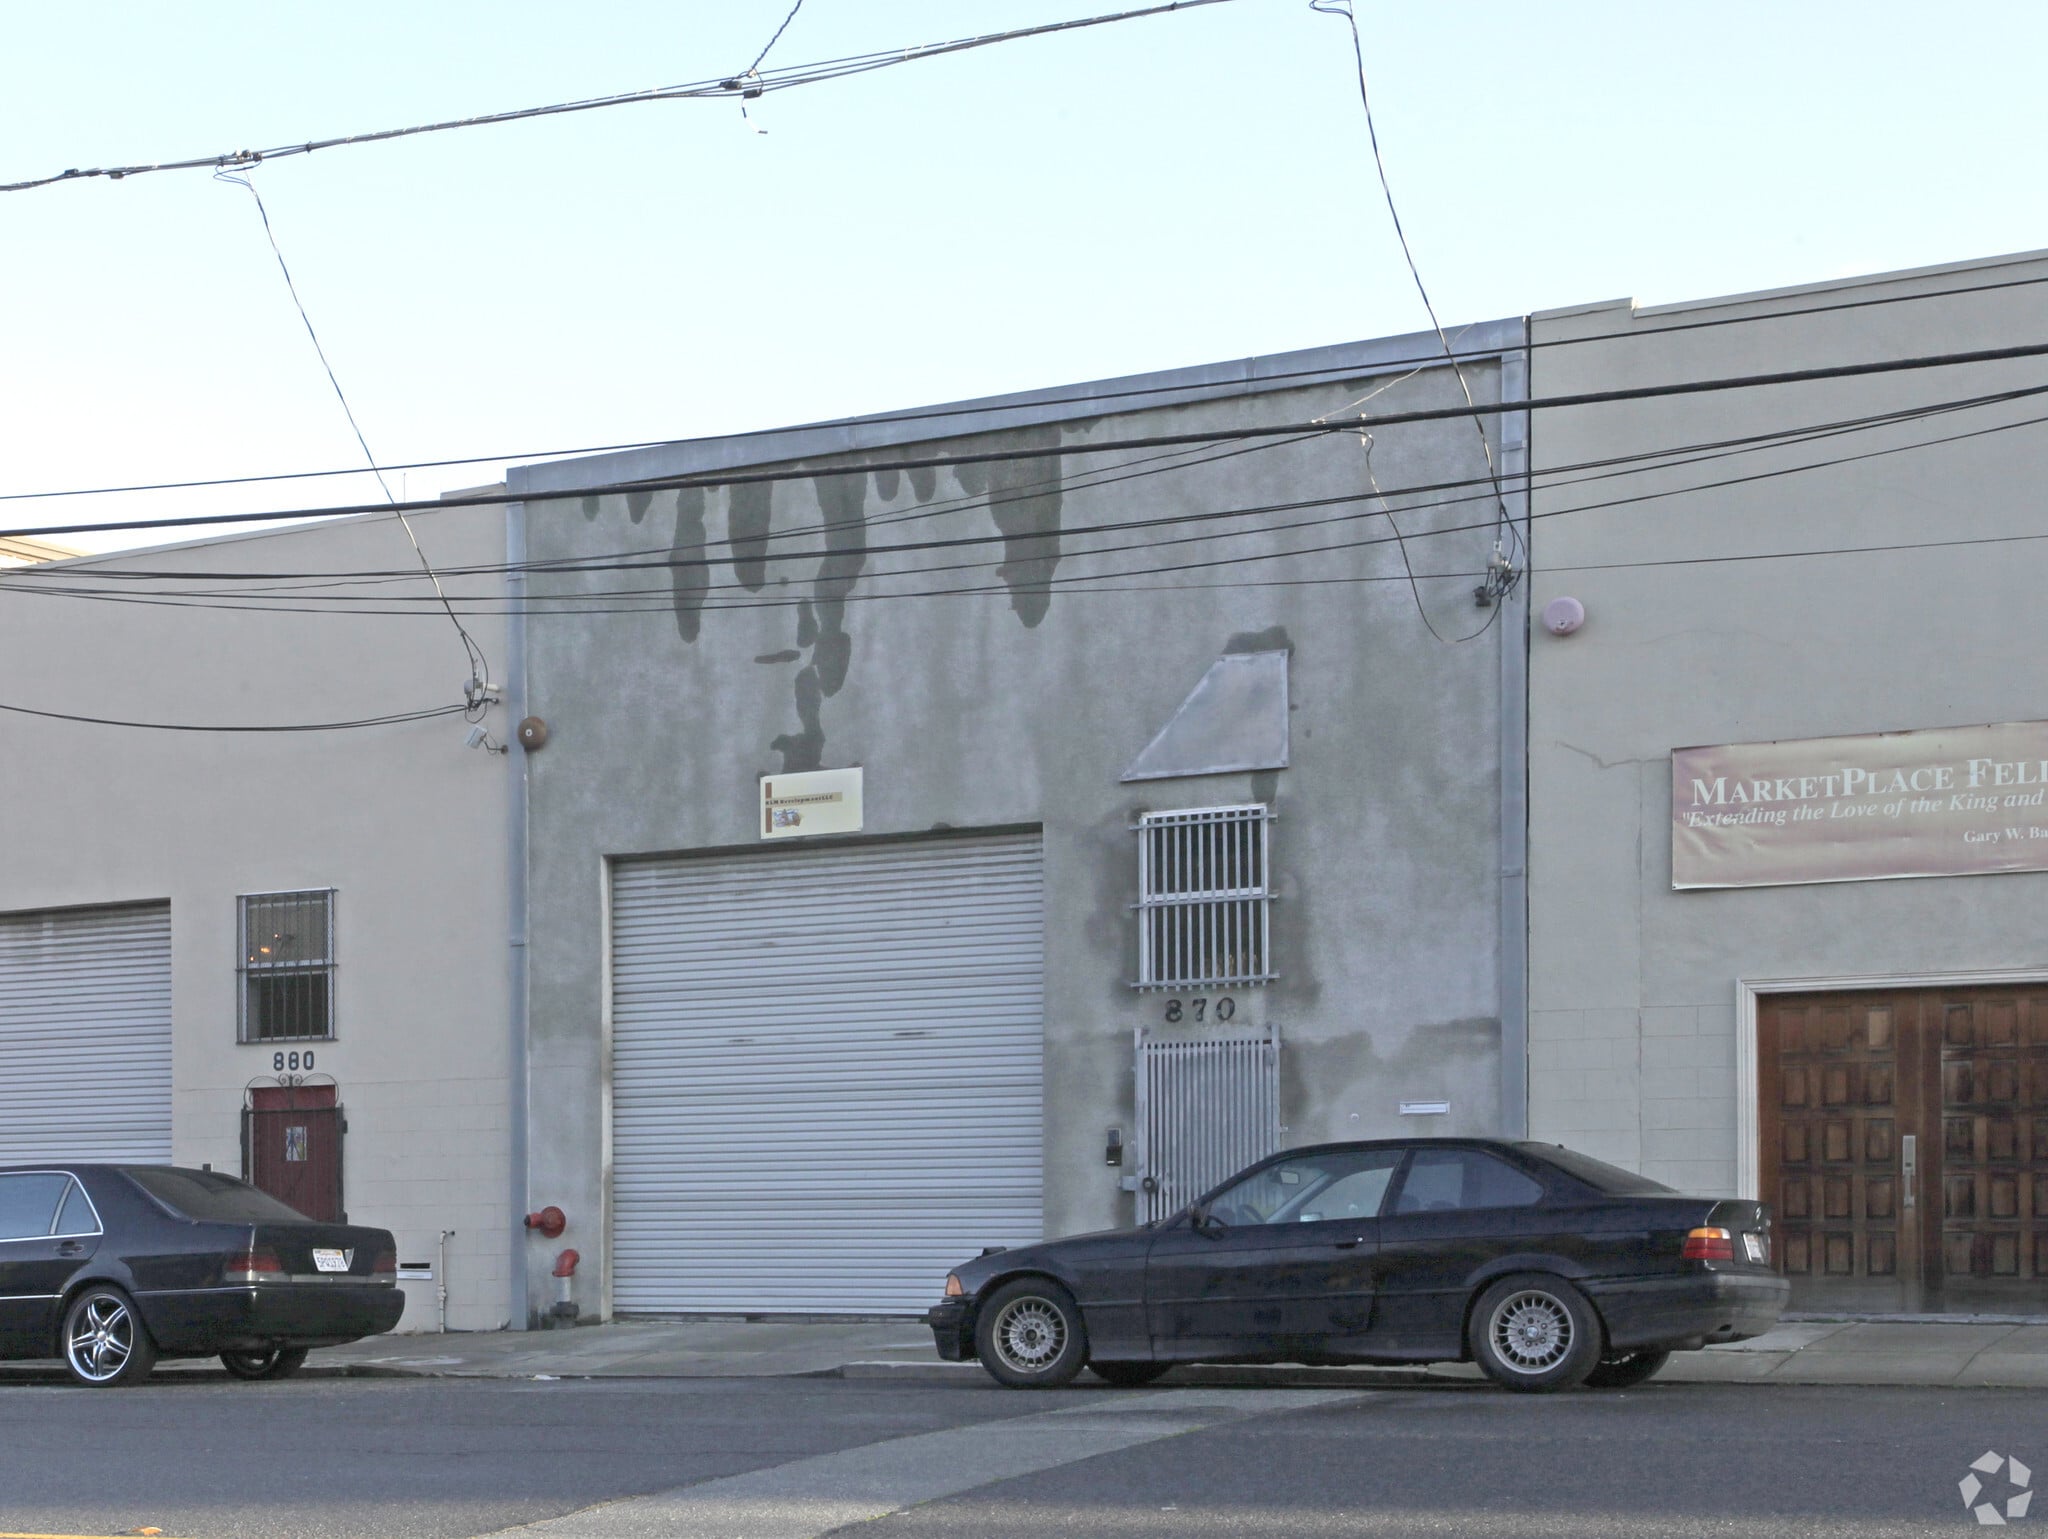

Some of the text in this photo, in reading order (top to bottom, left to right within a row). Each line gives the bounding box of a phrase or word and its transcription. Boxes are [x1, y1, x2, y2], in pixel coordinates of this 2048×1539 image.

[1691, 767, 1954, 807] MARKETPLACE
[1792, 803, 1824, 821] the
[1830, 801, 1878, 820] Love
[1883, 798, 1907, 818] of
[1910, 796, 1943, 814] the
[1949, 793, 1999, 813] King
[2004, 788, 2045, 808] and
[1963, 830, 2001, 844] Gary
[2005, 827, 2024, 840] W.
[1165, 997, 1236, 1023] 870
[273, 1050, 315, 1072] 880
